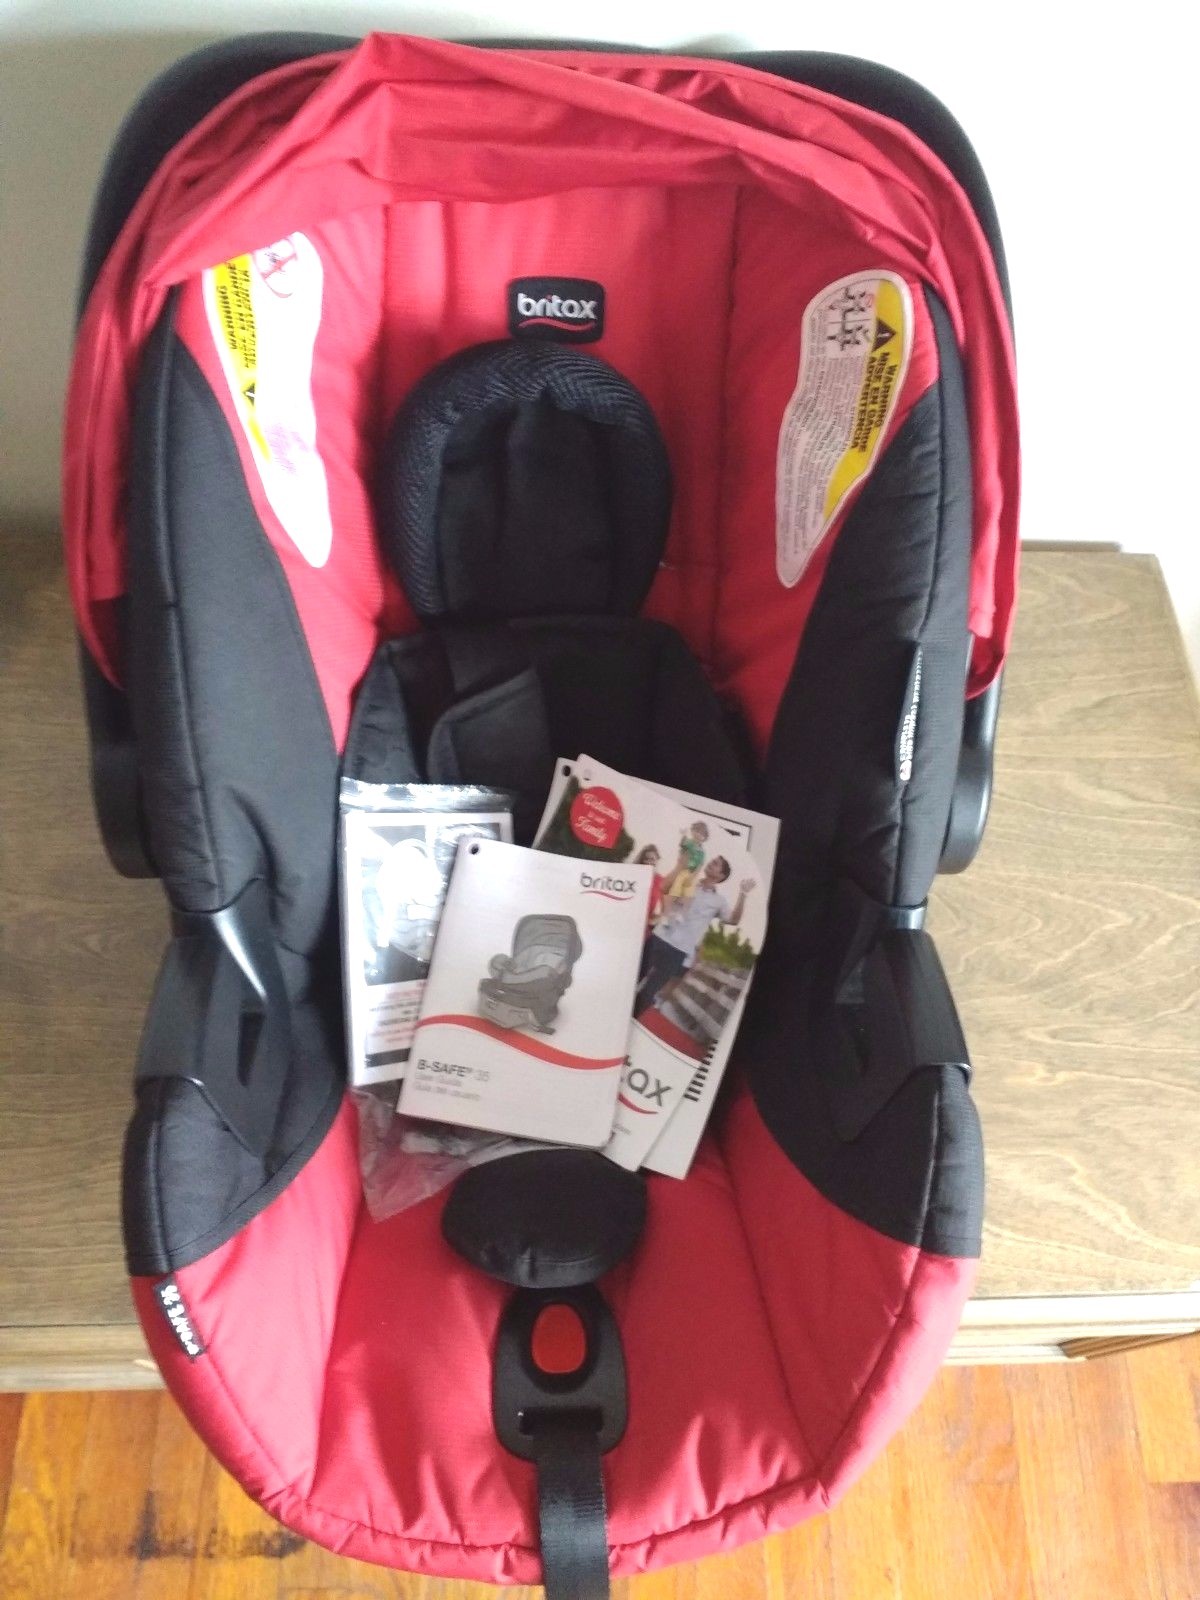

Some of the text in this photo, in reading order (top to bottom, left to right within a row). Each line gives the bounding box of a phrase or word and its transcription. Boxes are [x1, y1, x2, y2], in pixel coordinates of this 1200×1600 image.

[216, 285, 237, 350] WARNING
[517, 292, 598, 319] britax
[868, 386, 880, 405] EN
[873, 364, 898, 427] WARNING
[580, 872, 637, 893] britax
